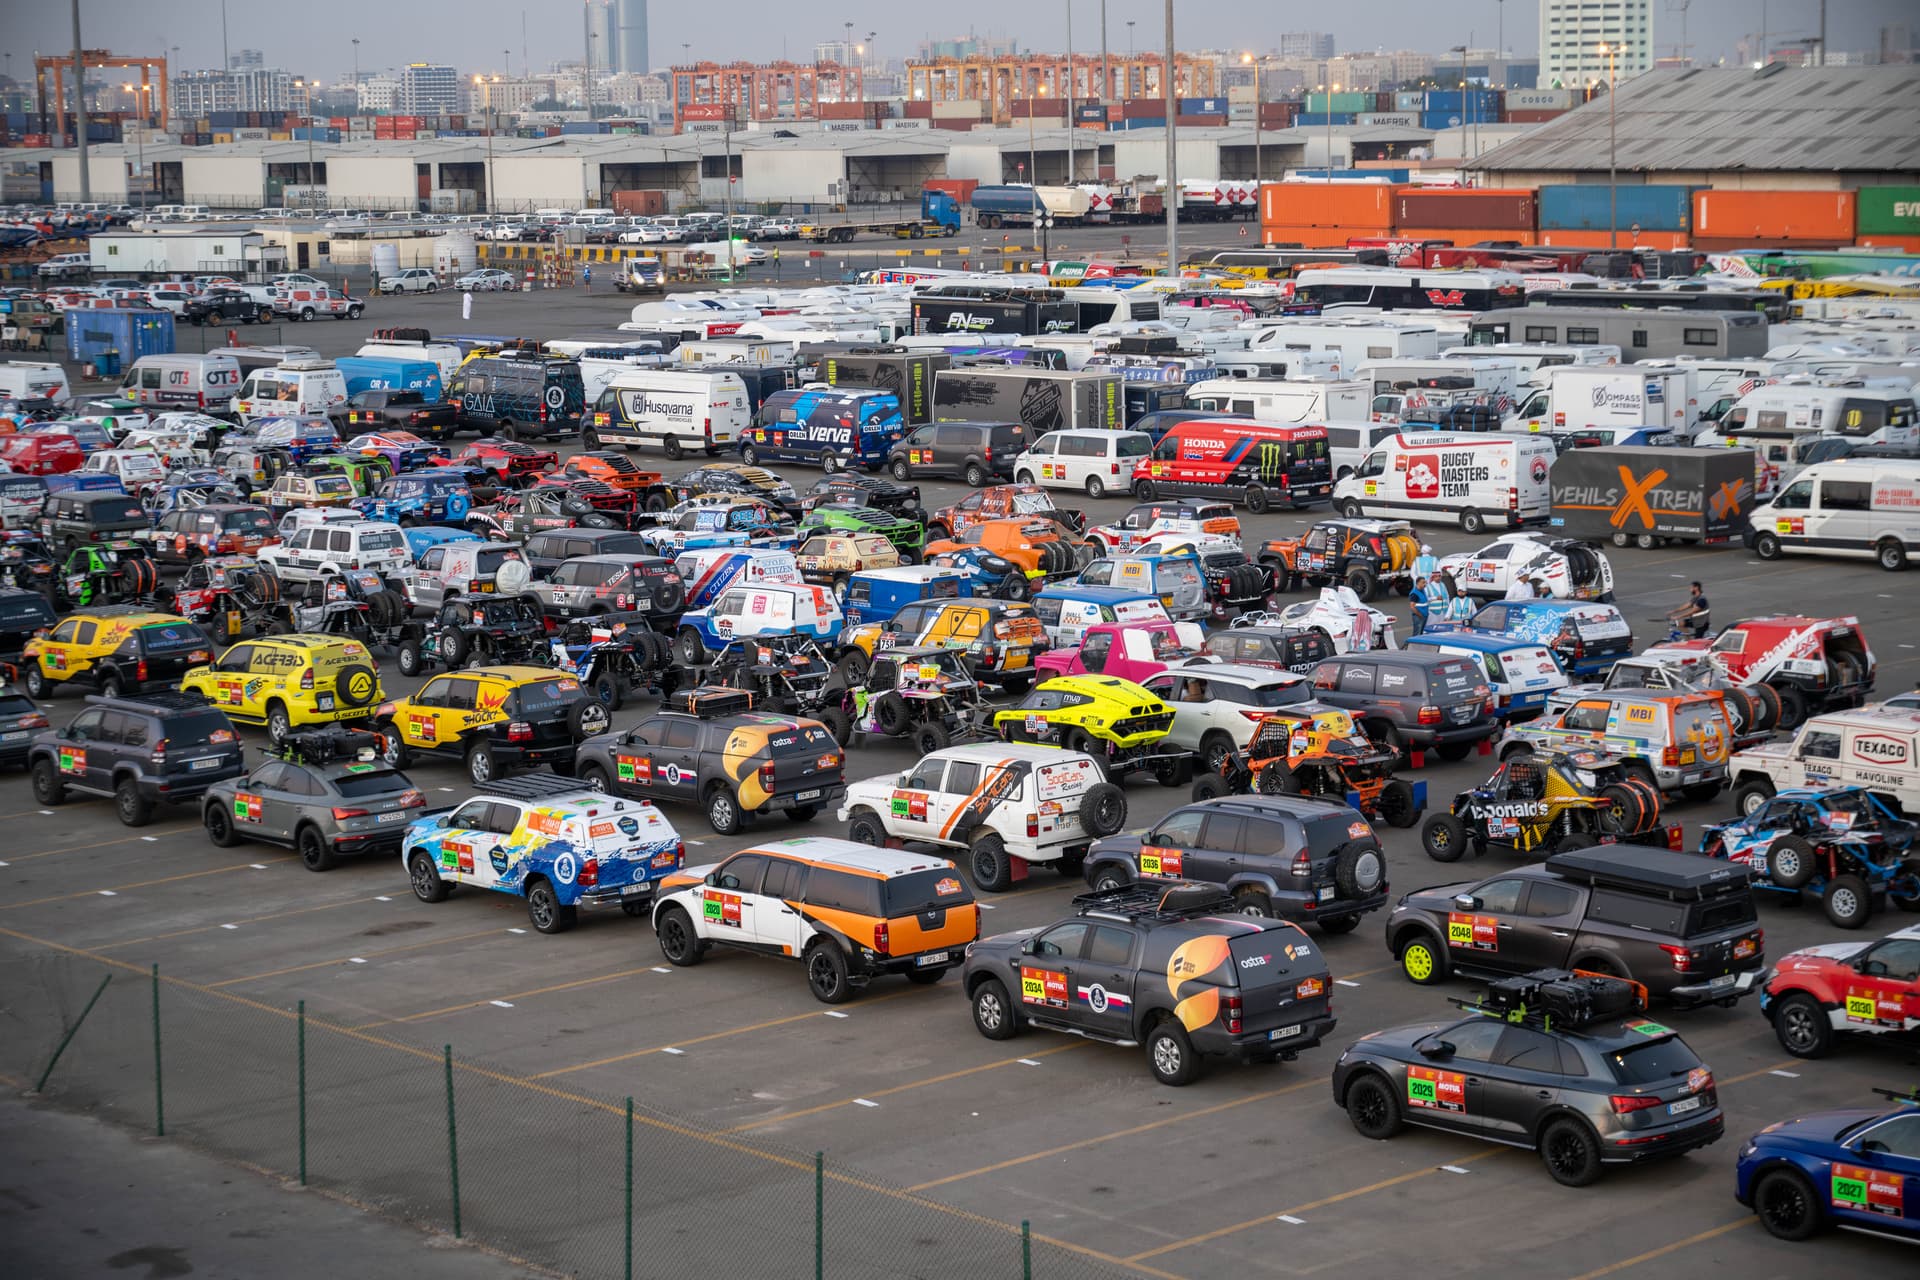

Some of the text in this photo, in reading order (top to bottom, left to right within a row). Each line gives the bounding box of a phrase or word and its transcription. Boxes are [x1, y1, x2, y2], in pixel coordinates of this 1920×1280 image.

[895, 121, 919, 129] MAERSK
[1373, 117, 1410, 126] MAERSK
[971, 317, 994, 325] SPEED
[170, 371, 189, 385] OT3
[207, 370, 239, 385] OT3
[464, 393, 495, 413] GAIA
[644, 398, 693, 415] Husqvarna
[789, 431, 806, 439] ORLEN
[809, 426, 852, 444] verva
[864, 425, 881, 433] ORLEN
[1292, 429, 1323, 438] HONDA
[1184, 438, 1226, 449] HONDA
[1441, 452, 1475, 467] BUGGY
[1441, 467, 1489, 483] MASTERS
[1441, 482, 1470, 498] TEAM
[1551, 485, 1618, 505] VEHILS
[1352, 543, 1368, 553] Oryx
[1298, 558, 1310, 568] 292
[607, 565, 630, 586] TESLA
[764, 565, 793, 576] CITIZEN
[1125, 566, 1140, 575] MBI
[1468, 568, 1480, 578] 274
[709, 563, 735, 594] CITIZEN
[848, 616, 860, 626] 760
[719, 627, 732, 638] 803
[252, 653, 305, 667] ACERBIS
[325, 656, 359, 666] ACERBIS
[1629, 707, 1653, 721] MBI
[1856, 740, 1905, 758] TEXACO
[1803, 763, 1832, 775] TEXACO
[1855, 771, 1904, 786] HAVOLINE
[1143, 858, 1159, 870] 2036
[706, 903, 720, 915] 2020
[724, 903, 738, 912] MOTUL
[1452, 926, 1471, 938] 2048
[1475, 926, 1494, 934] MOTUL
[1025, 981, 1042, 994] 2034
[1046, 982, 1064, 991] MOTUL
[1850, 1001, 1872, 1015] 2030
[1878, 1001, 1902, 1011] MOTUL
[1412, 1082, 1433, 1097] 2029
[1438, 1083, 1460, 1093] MOTUL
[1838, 1181, 1862, 1198] 2027
[1869, 1183, 1899, 1196] MOTUL
